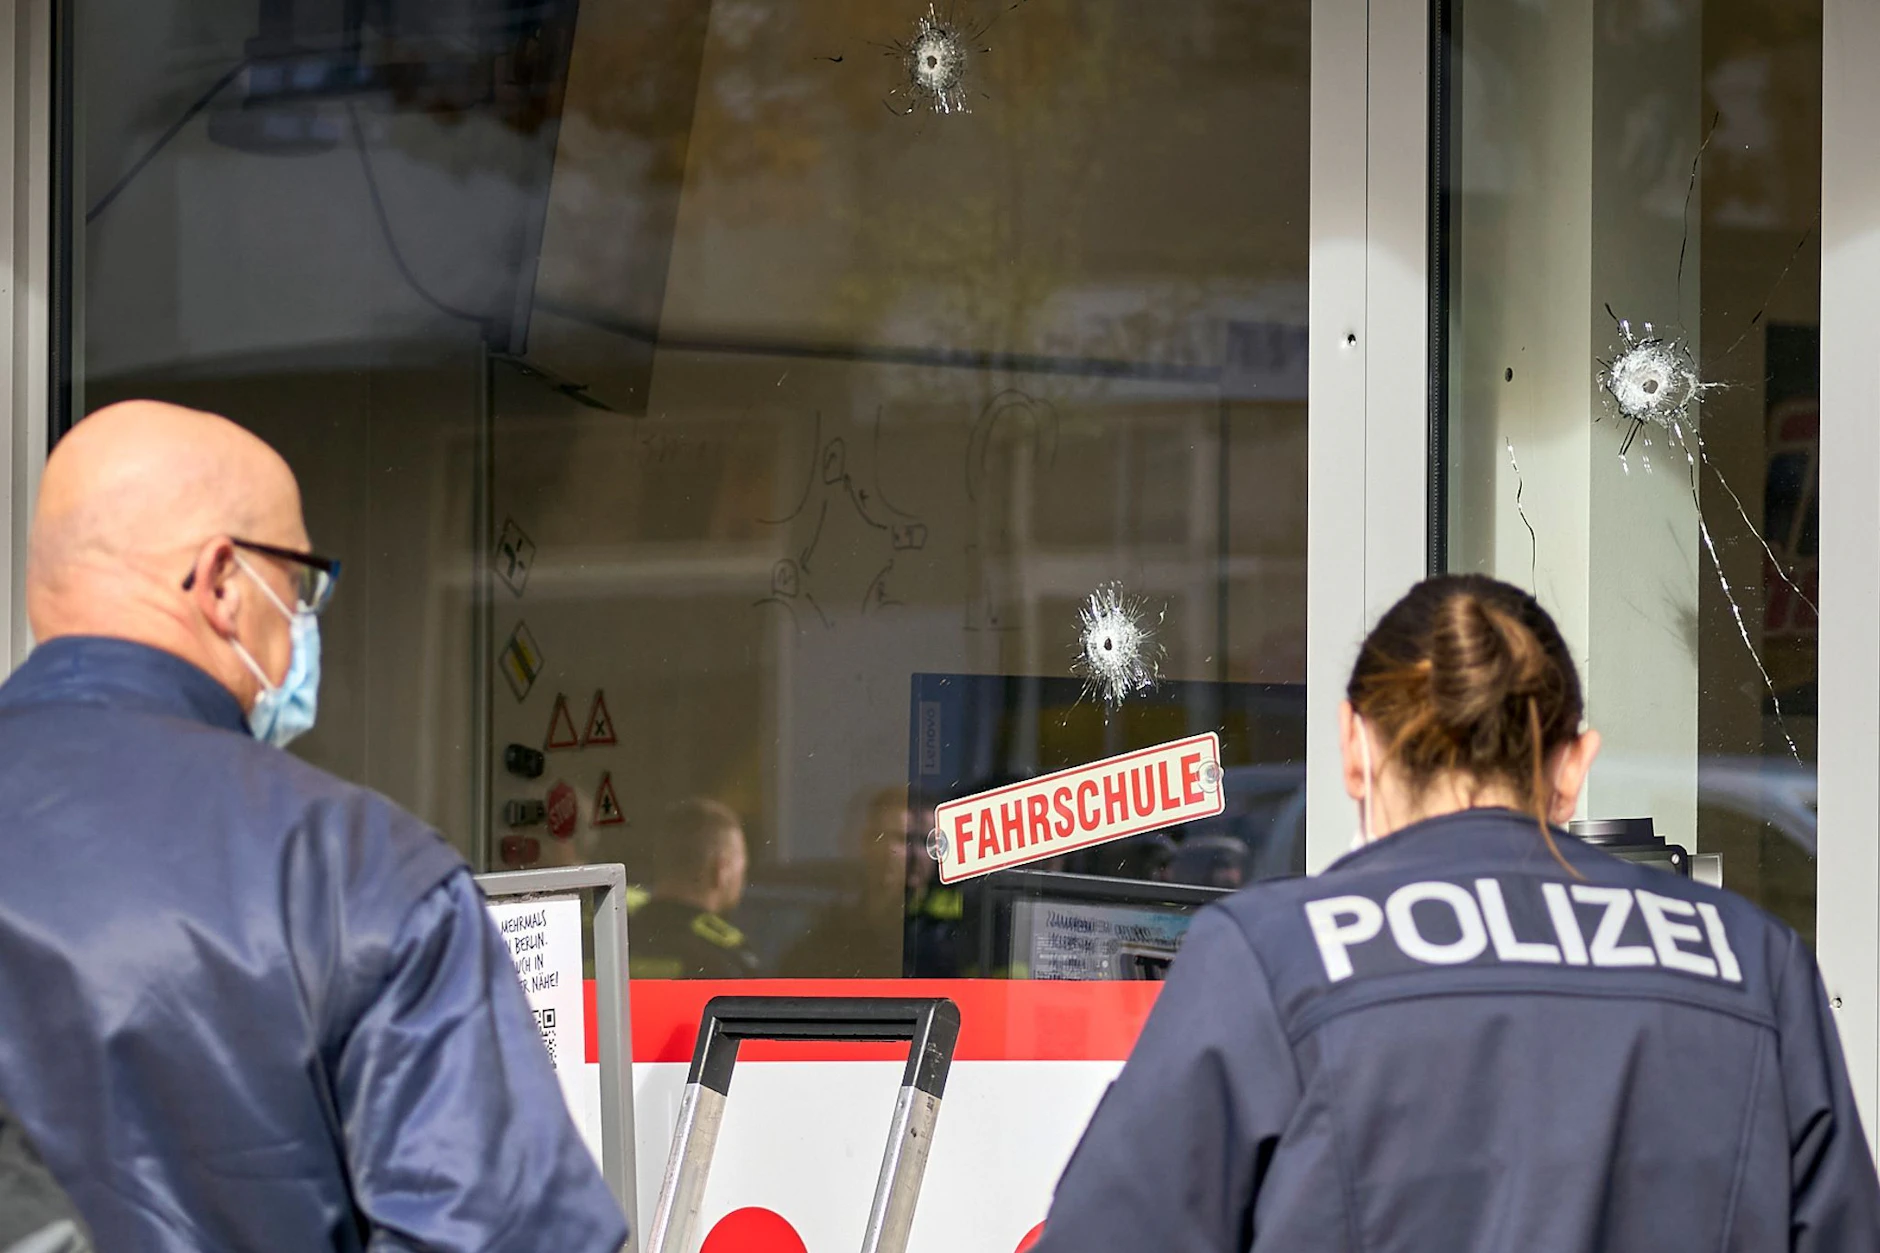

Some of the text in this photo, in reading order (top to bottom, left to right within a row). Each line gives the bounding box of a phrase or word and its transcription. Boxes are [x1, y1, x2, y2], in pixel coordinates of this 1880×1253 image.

[924, 708, 936, 769] Lenovo
[954, 752, 1205, 865] FAHRSCHULE
[501, 909, 547, 935] MEHRMALS
[1304, 878, 1742, 983] POLIZEI
[514, 931, 548, 955] BERLIN.
[534, 953, 544, 971] IN
[532, 970, 559, 994] NÄHE!
